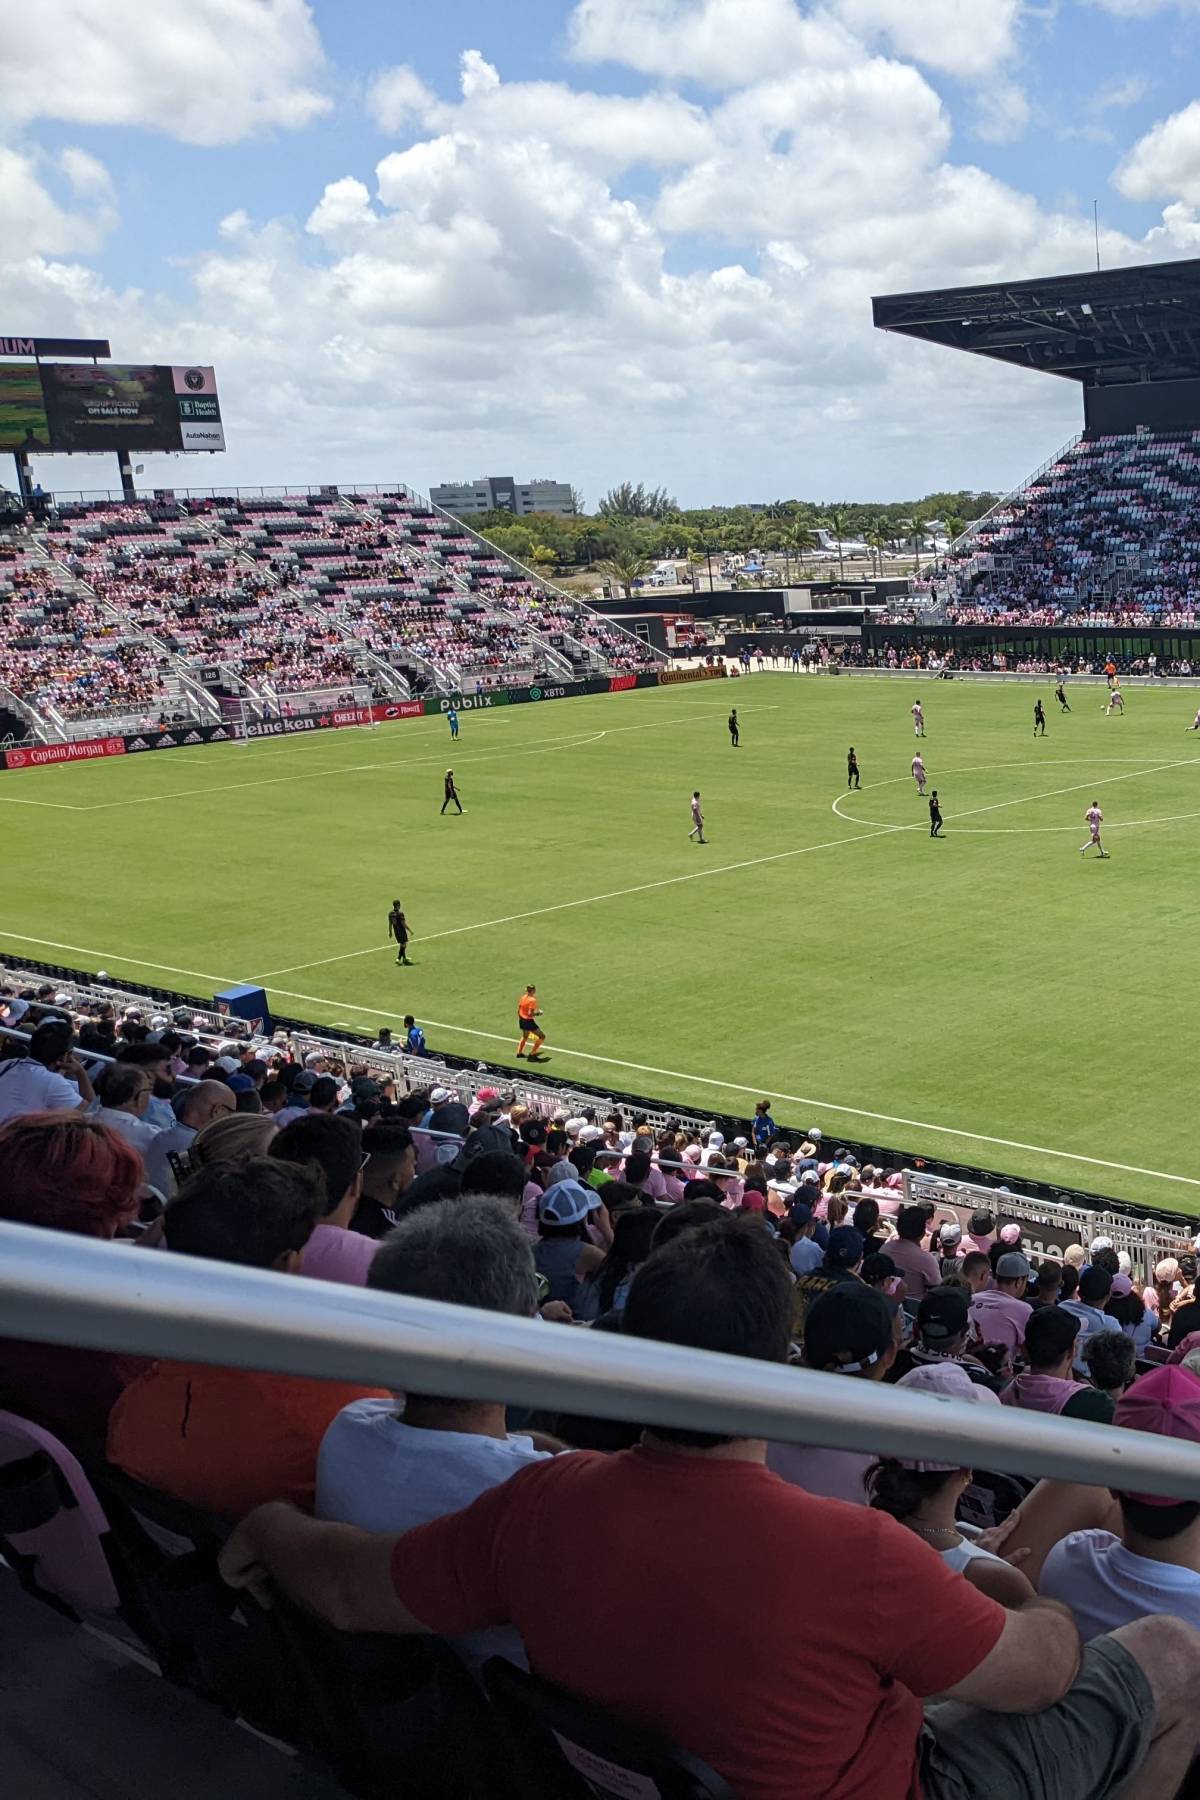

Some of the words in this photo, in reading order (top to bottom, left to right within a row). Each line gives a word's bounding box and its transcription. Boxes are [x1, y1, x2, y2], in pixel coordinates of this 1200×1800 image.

[660, 668, 700, 684] Continental
[543, 687, 565, 698] XBTO
[234, 717, 316, 738] Heineken
[30, 749, 66, 764] Captain
[66, 743, 104, 760] Morgan
